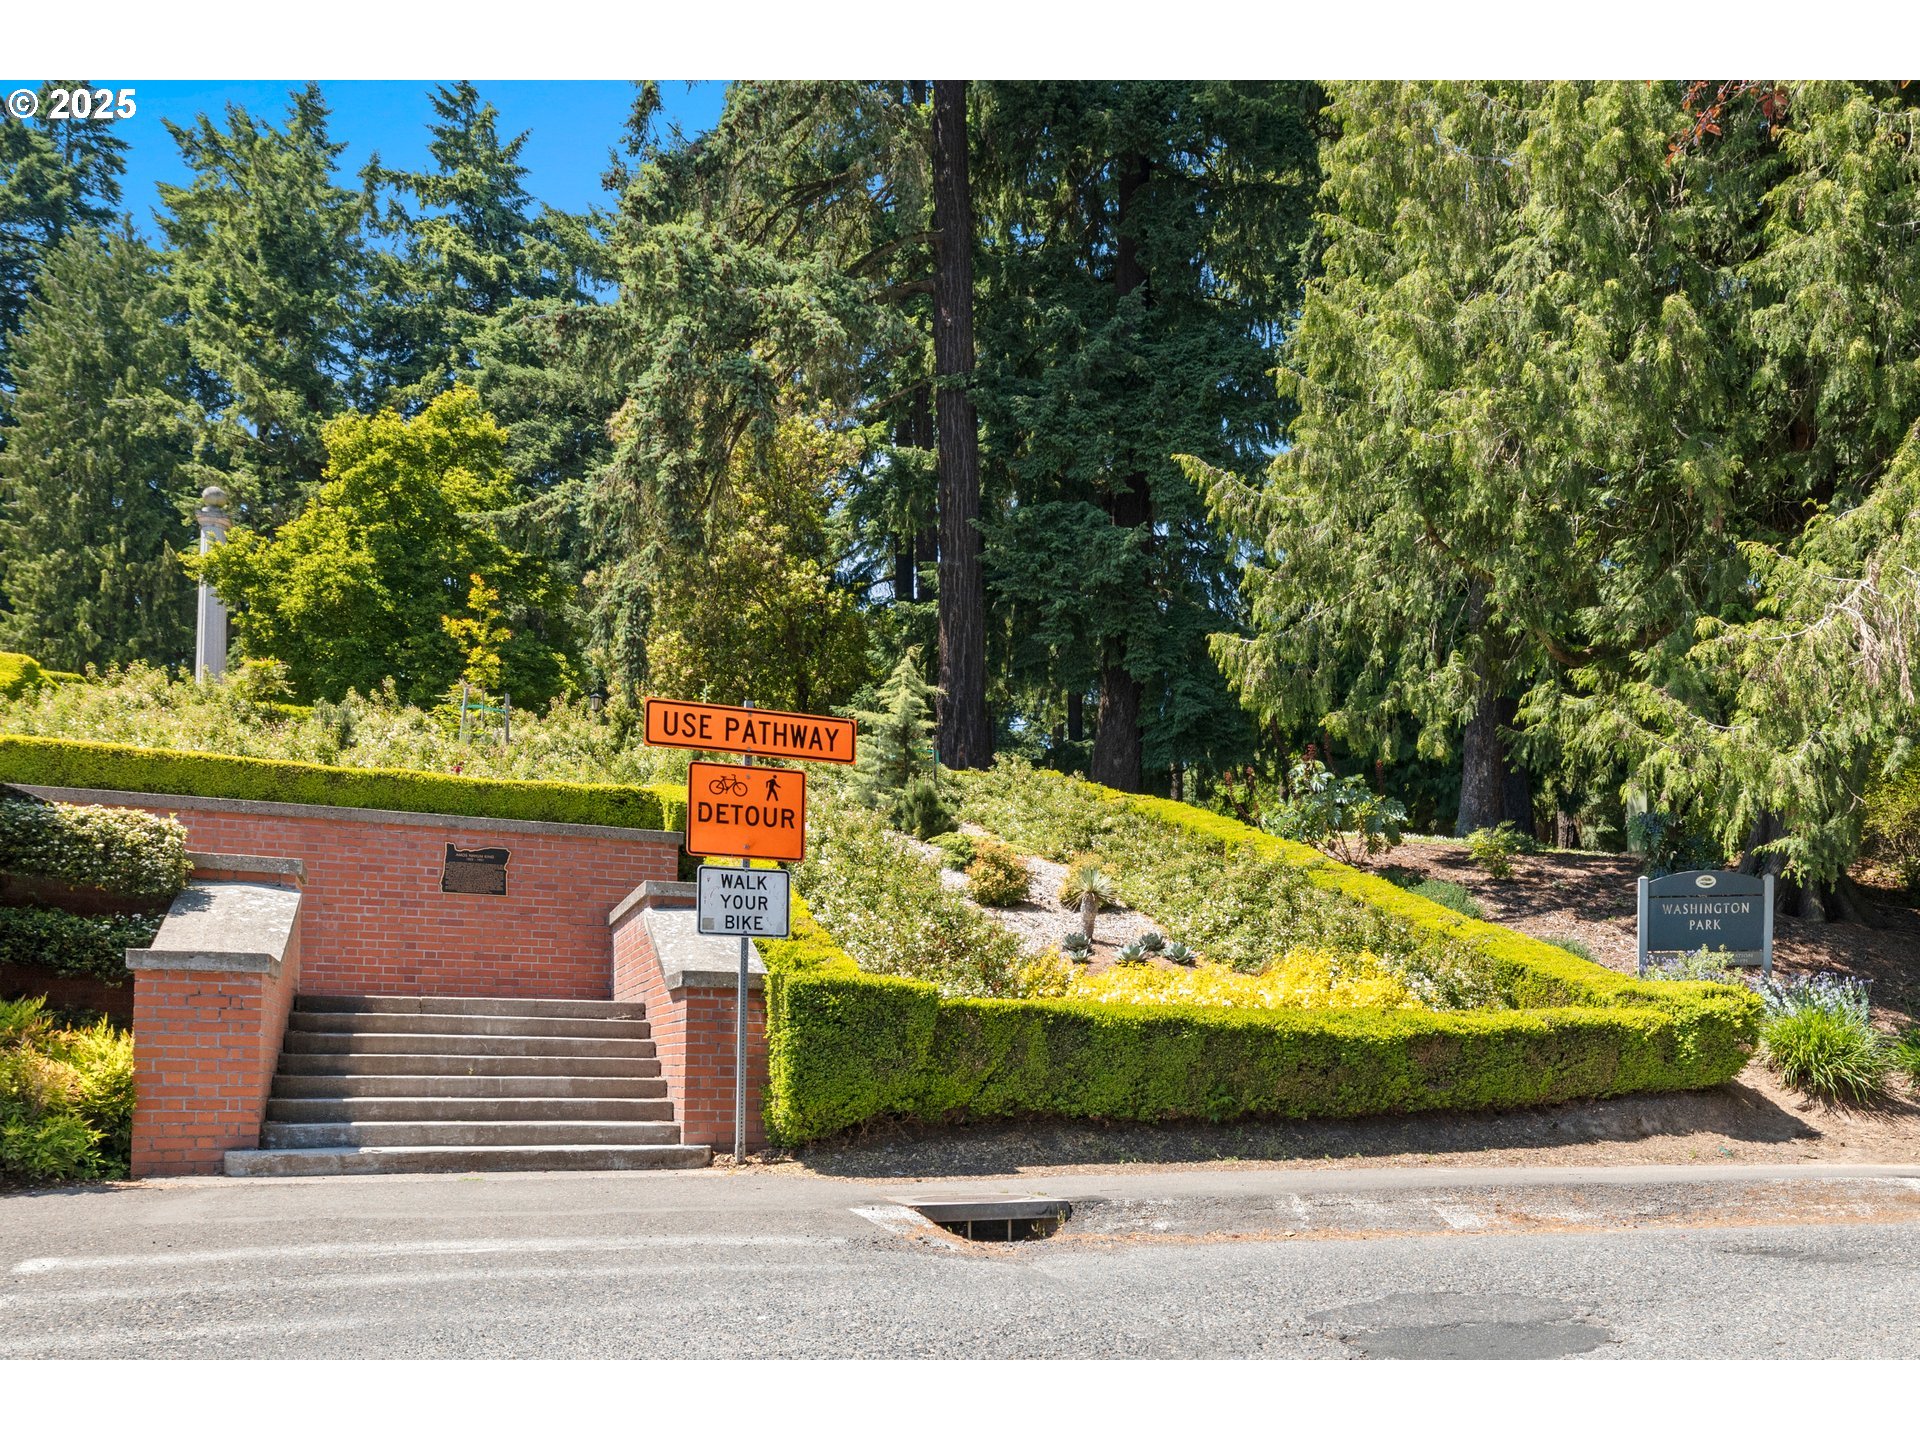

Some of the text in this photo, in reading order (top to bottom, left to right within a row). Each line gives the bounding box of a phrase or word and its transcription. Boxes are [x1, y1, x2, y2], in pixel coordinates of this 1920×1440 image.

[663, 710, 839, 752] USE PATHWAY
[698, 802, 795, 829] DETOUR
[721, 873, 768, 891] WALK
[720, 894, 768, 911] YOUR
[1662, 902, 1750, 914] WASHINGTON
[724, 915, 764, 931] BIKE
[1689, 919, 1721, 931] PARK
